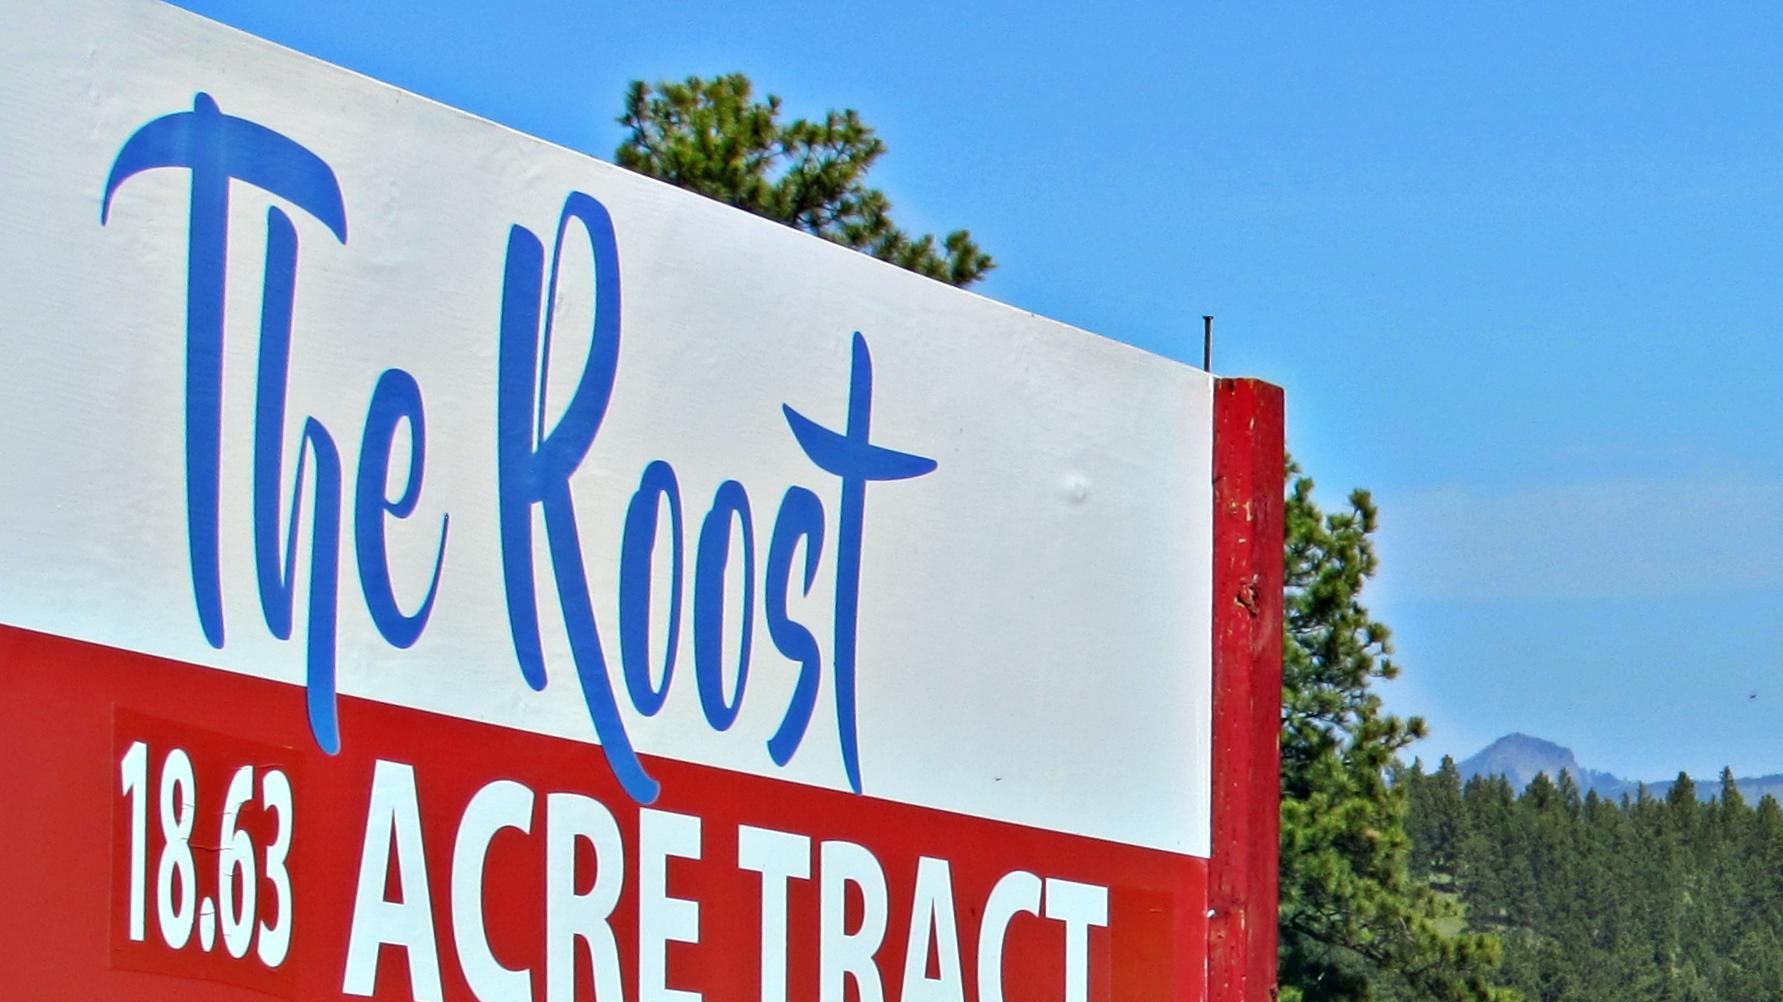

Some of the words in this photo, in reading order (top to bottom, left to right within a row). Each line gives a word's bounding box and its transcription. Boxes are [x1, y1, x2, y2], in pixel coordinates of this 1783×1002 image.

[102, 92, 450, 756] The
[498, 191, 938, 804] Roost
[121, 740, 293, 968] 18.63
